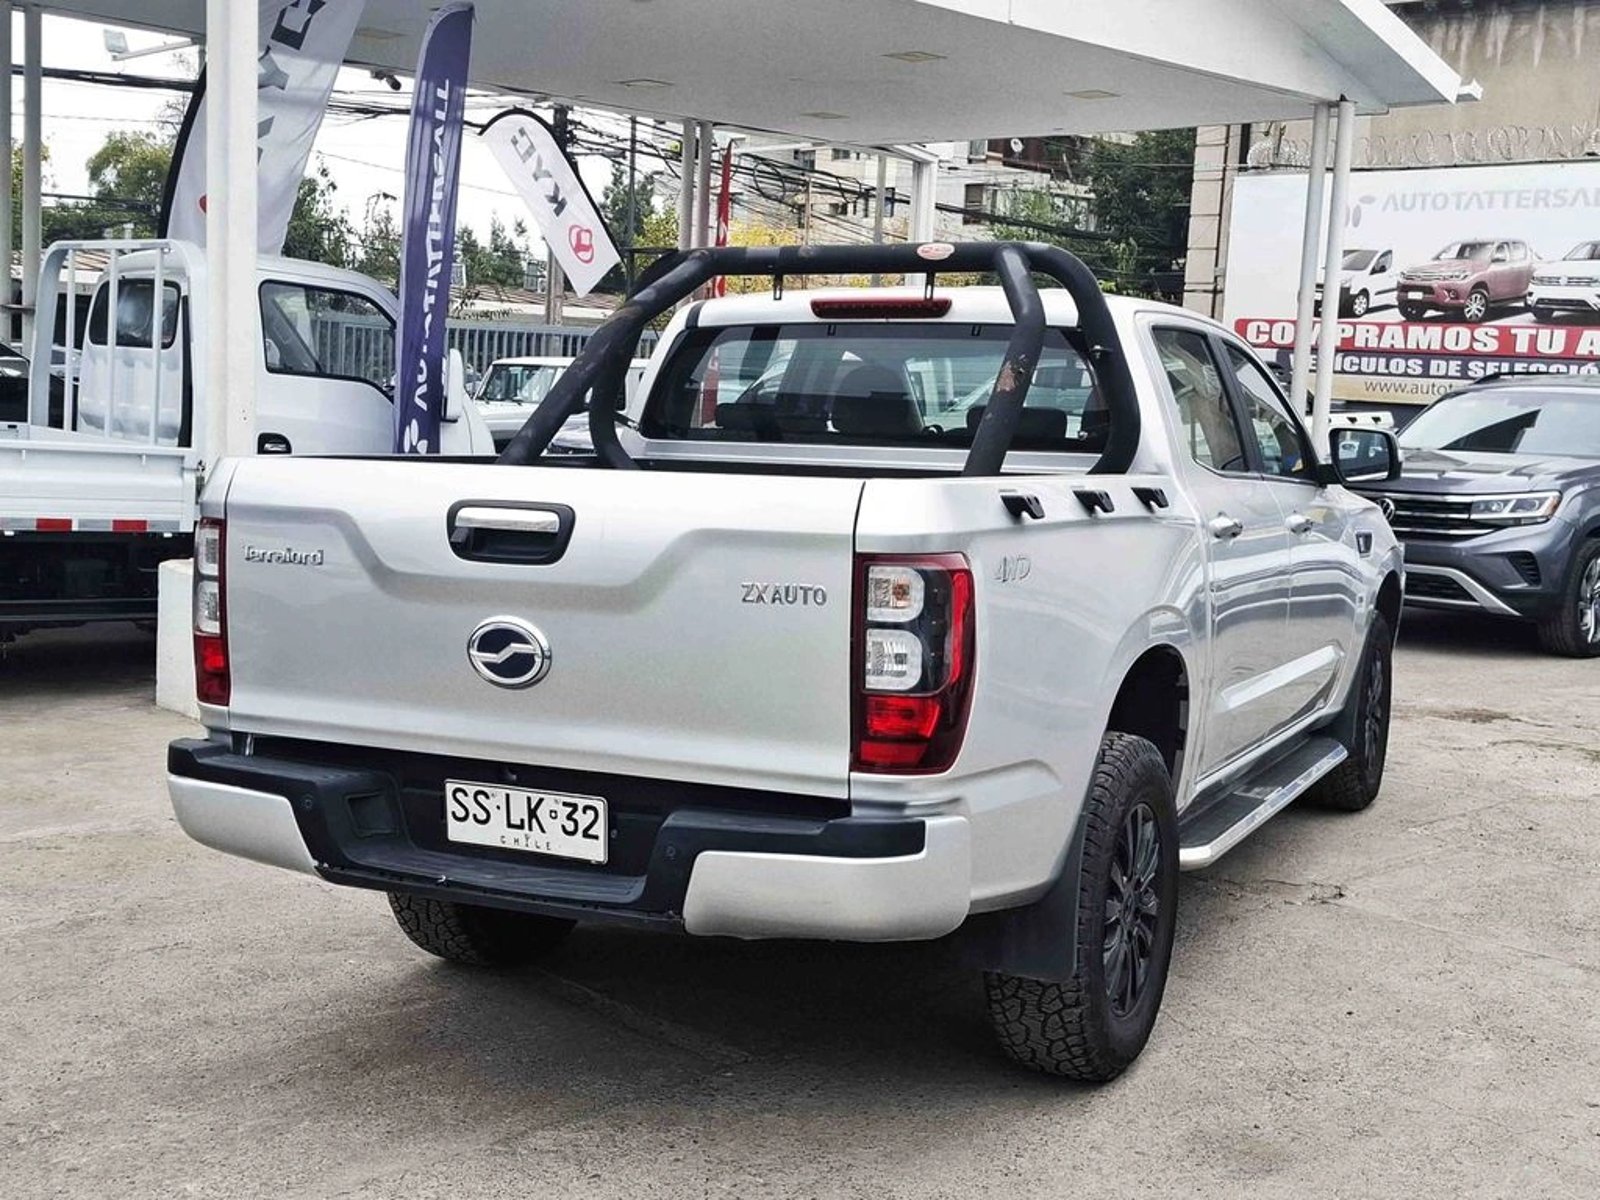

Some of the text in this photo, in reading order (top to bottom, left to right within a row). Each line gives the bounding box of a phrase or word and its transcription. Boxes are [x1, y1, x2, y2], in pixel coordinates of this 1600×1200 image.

[1510, 328, 1567, 354] TU
[1289, 353, 1423, 376] EÍCULOS
[1429, 359, 1462, 377] DE
[500, 834, 552, 851] CHILE
